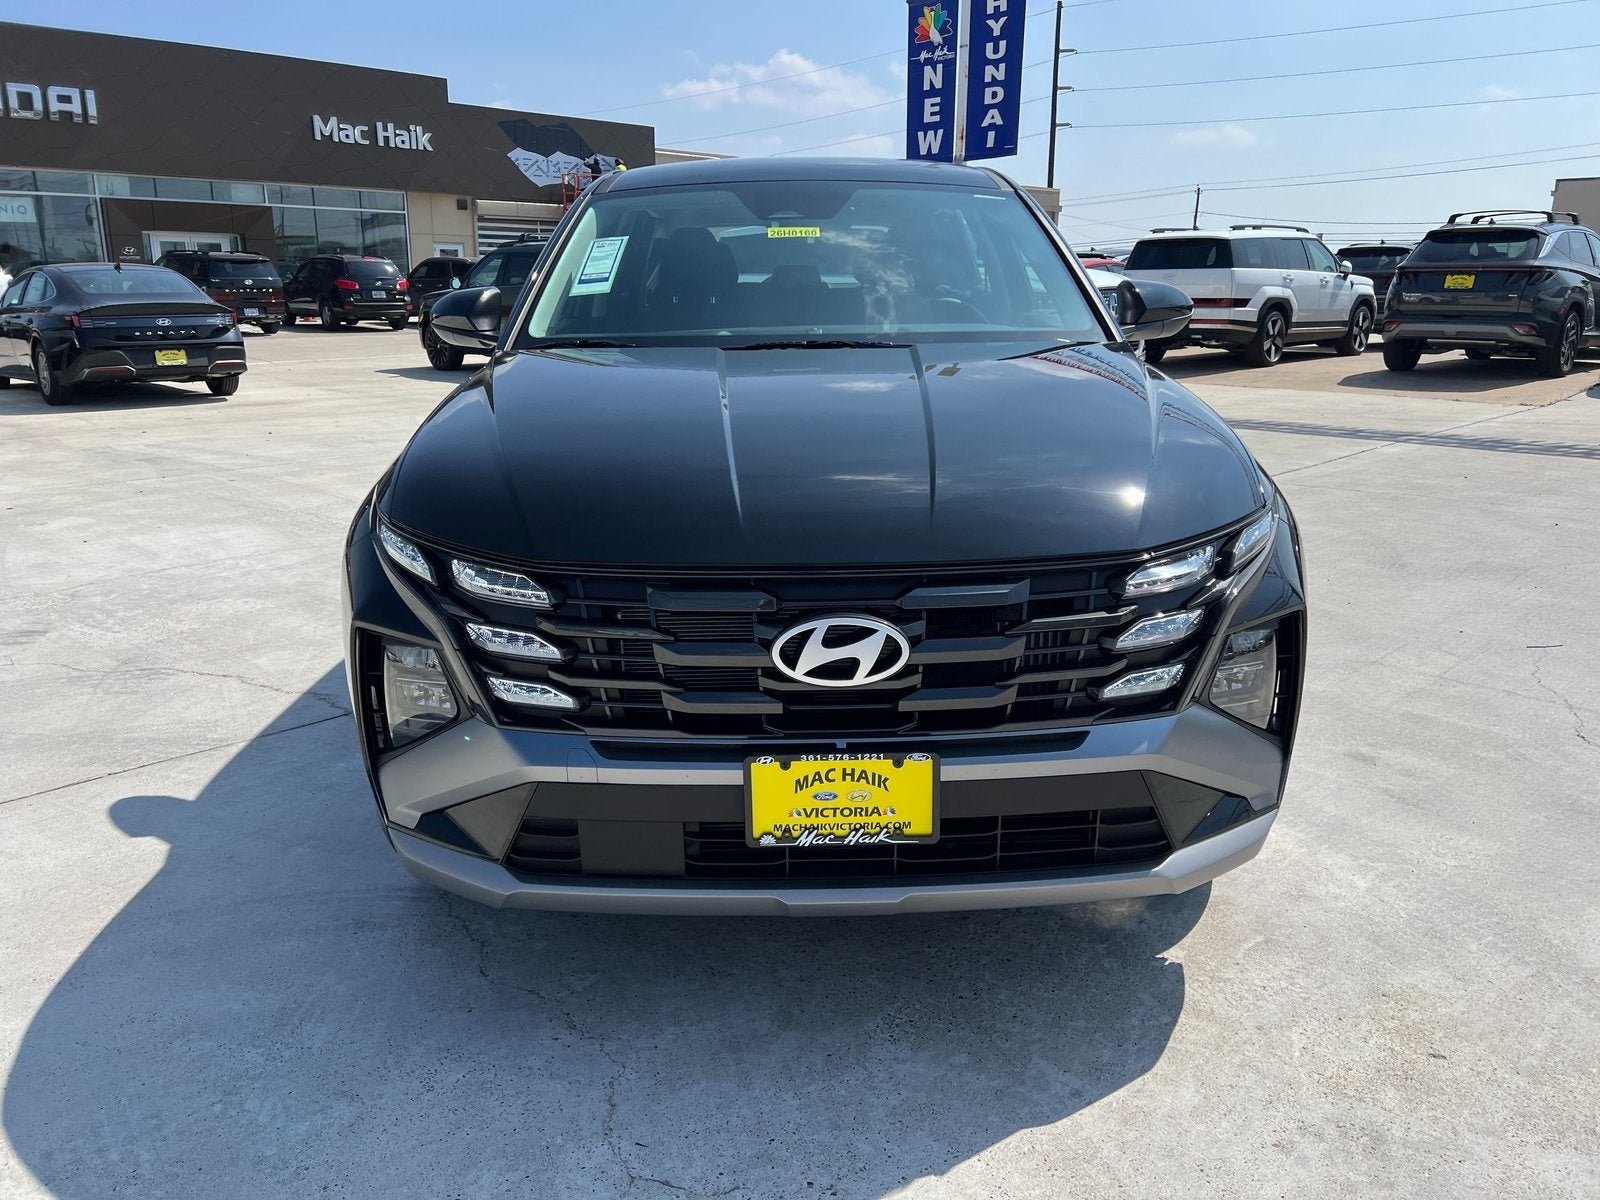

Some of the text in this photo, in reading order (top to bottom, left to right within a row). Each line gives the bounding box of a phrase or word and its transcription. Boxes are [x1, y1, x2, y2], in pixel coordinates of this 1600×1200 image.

[980, 0, 1008, 148] HYUNDAI
[0, 82, 98, 125] DAI
[917, 63, 944, 156] NEW
[312, 114, 434, 151] Mac Haik
[769, 229, 818, 237] 26H0160
[800, 753, 885, 761] 361-576-1221
[794, 767, 890, 794] MAC HAIK
[802, 806, 882, 818] VICTORIA
[791, 827, 897, 847] Mac Haik
